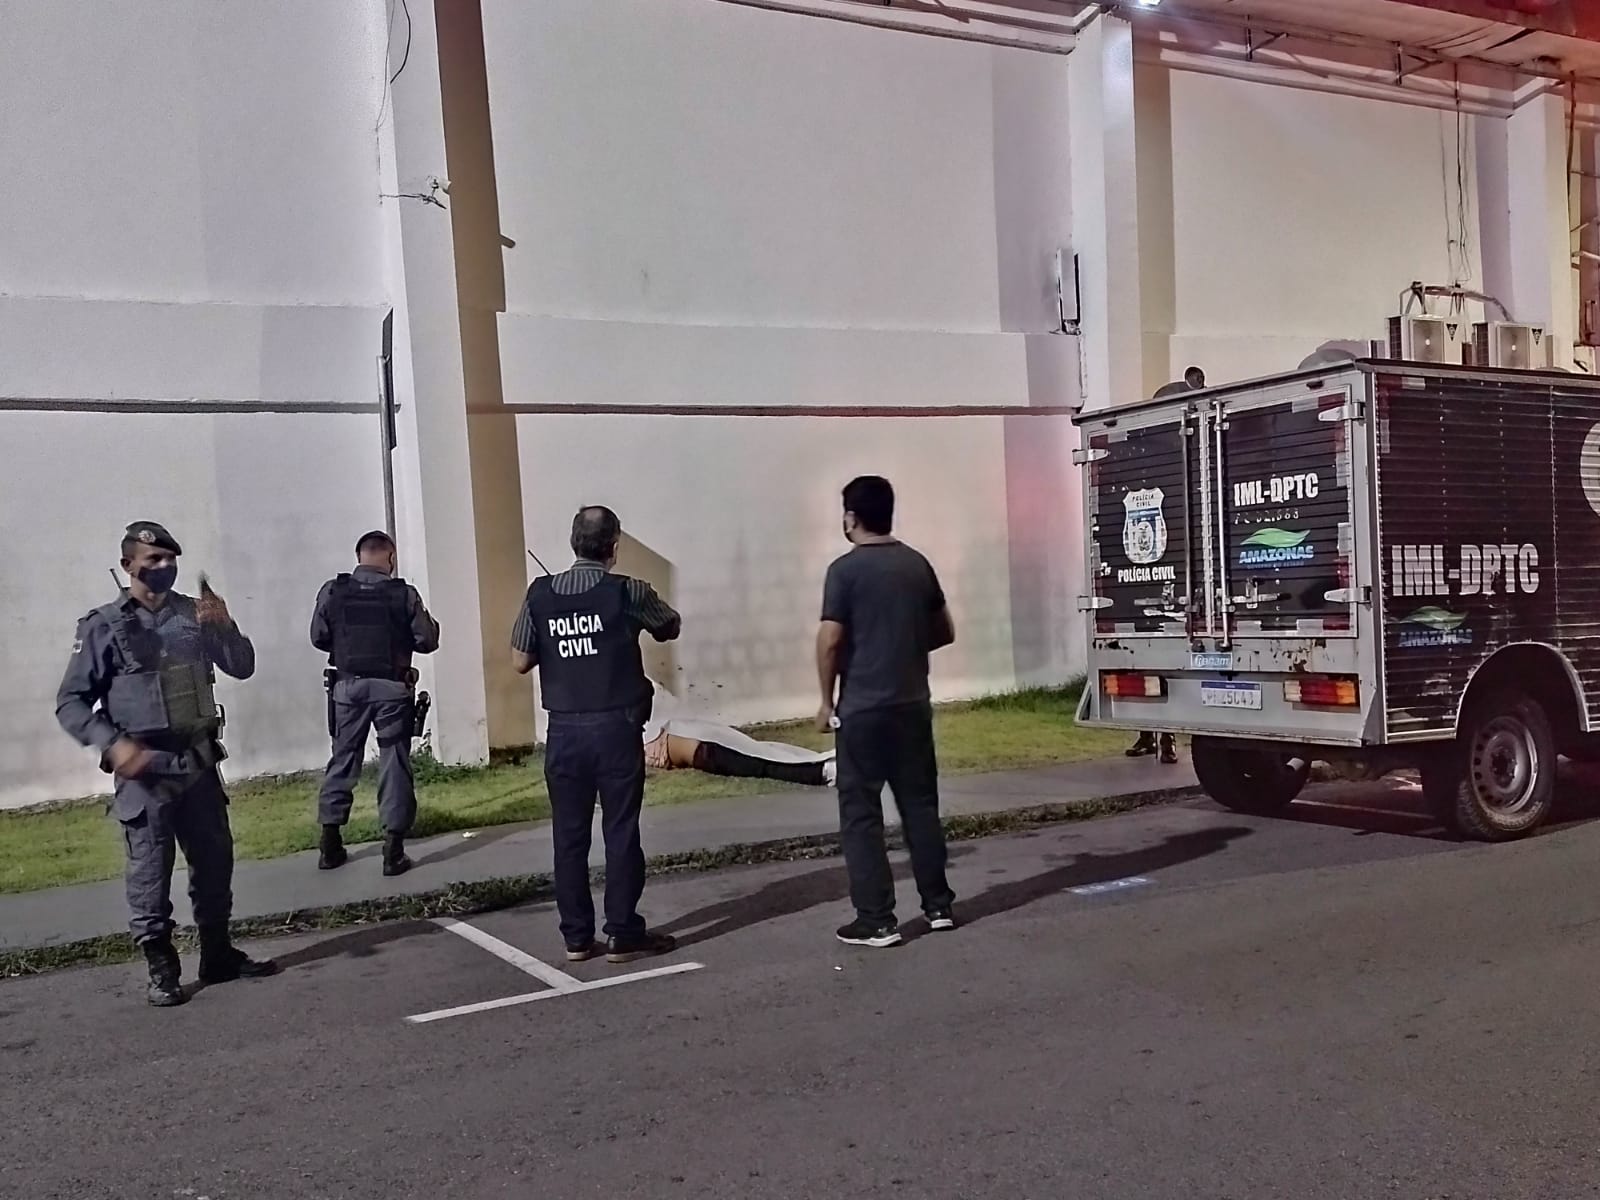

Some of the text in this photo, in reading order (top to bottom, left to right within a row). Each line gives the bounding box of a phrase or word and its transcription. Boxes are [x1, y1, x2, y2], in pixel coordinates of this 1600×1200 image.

[1239, 545, 1314, 564] AMAZONAS
[1118, 565, 1176, 583] POLÍCIA CIVIL
[1392, 543, 1539, 596] IML-DPTC
[548, 612, 604, 637] POLÍCIA
[558, 637, 598, 658] CIVIL
